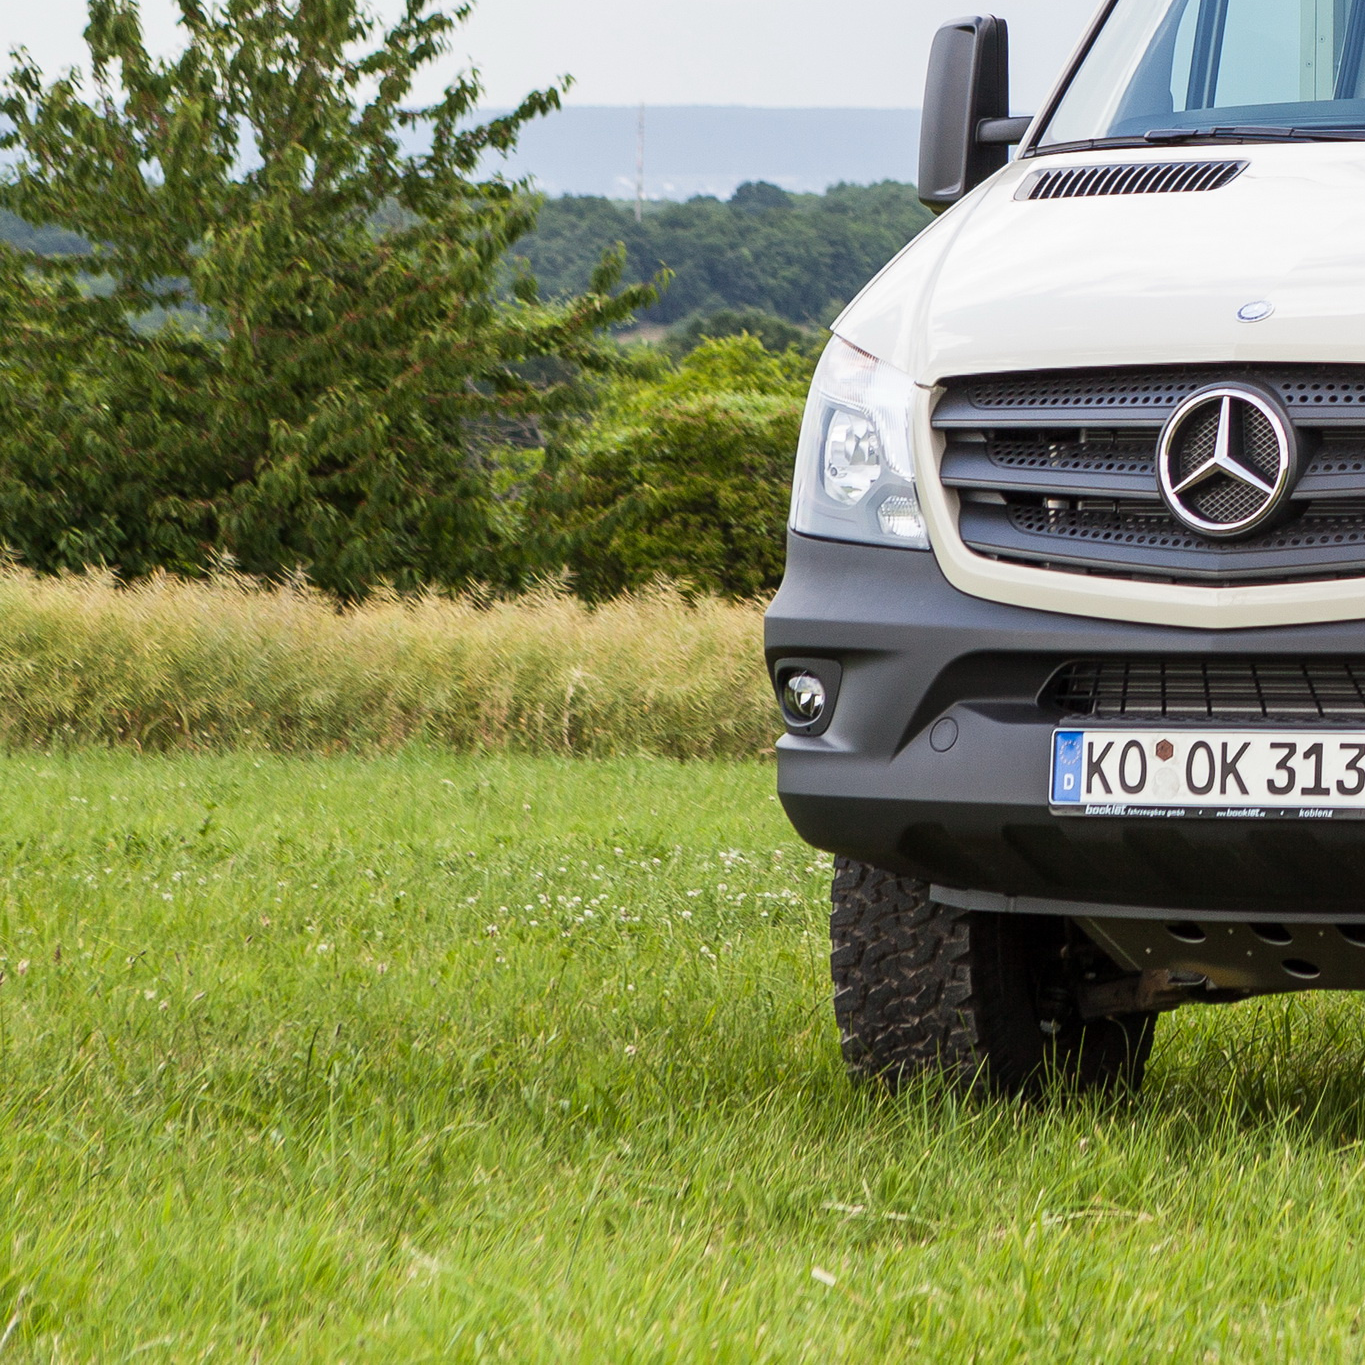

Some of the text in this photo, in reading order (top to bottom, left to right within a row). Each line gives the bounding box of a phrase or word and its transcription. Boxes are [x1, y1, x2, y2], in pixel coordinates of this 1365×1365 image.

[1086, 739, 1147, 795] KO
[1185, 739, 1251, 796] OK
[1063, 773, 1075, 791] D
[1085, 804, 1127, 815] bocklet
